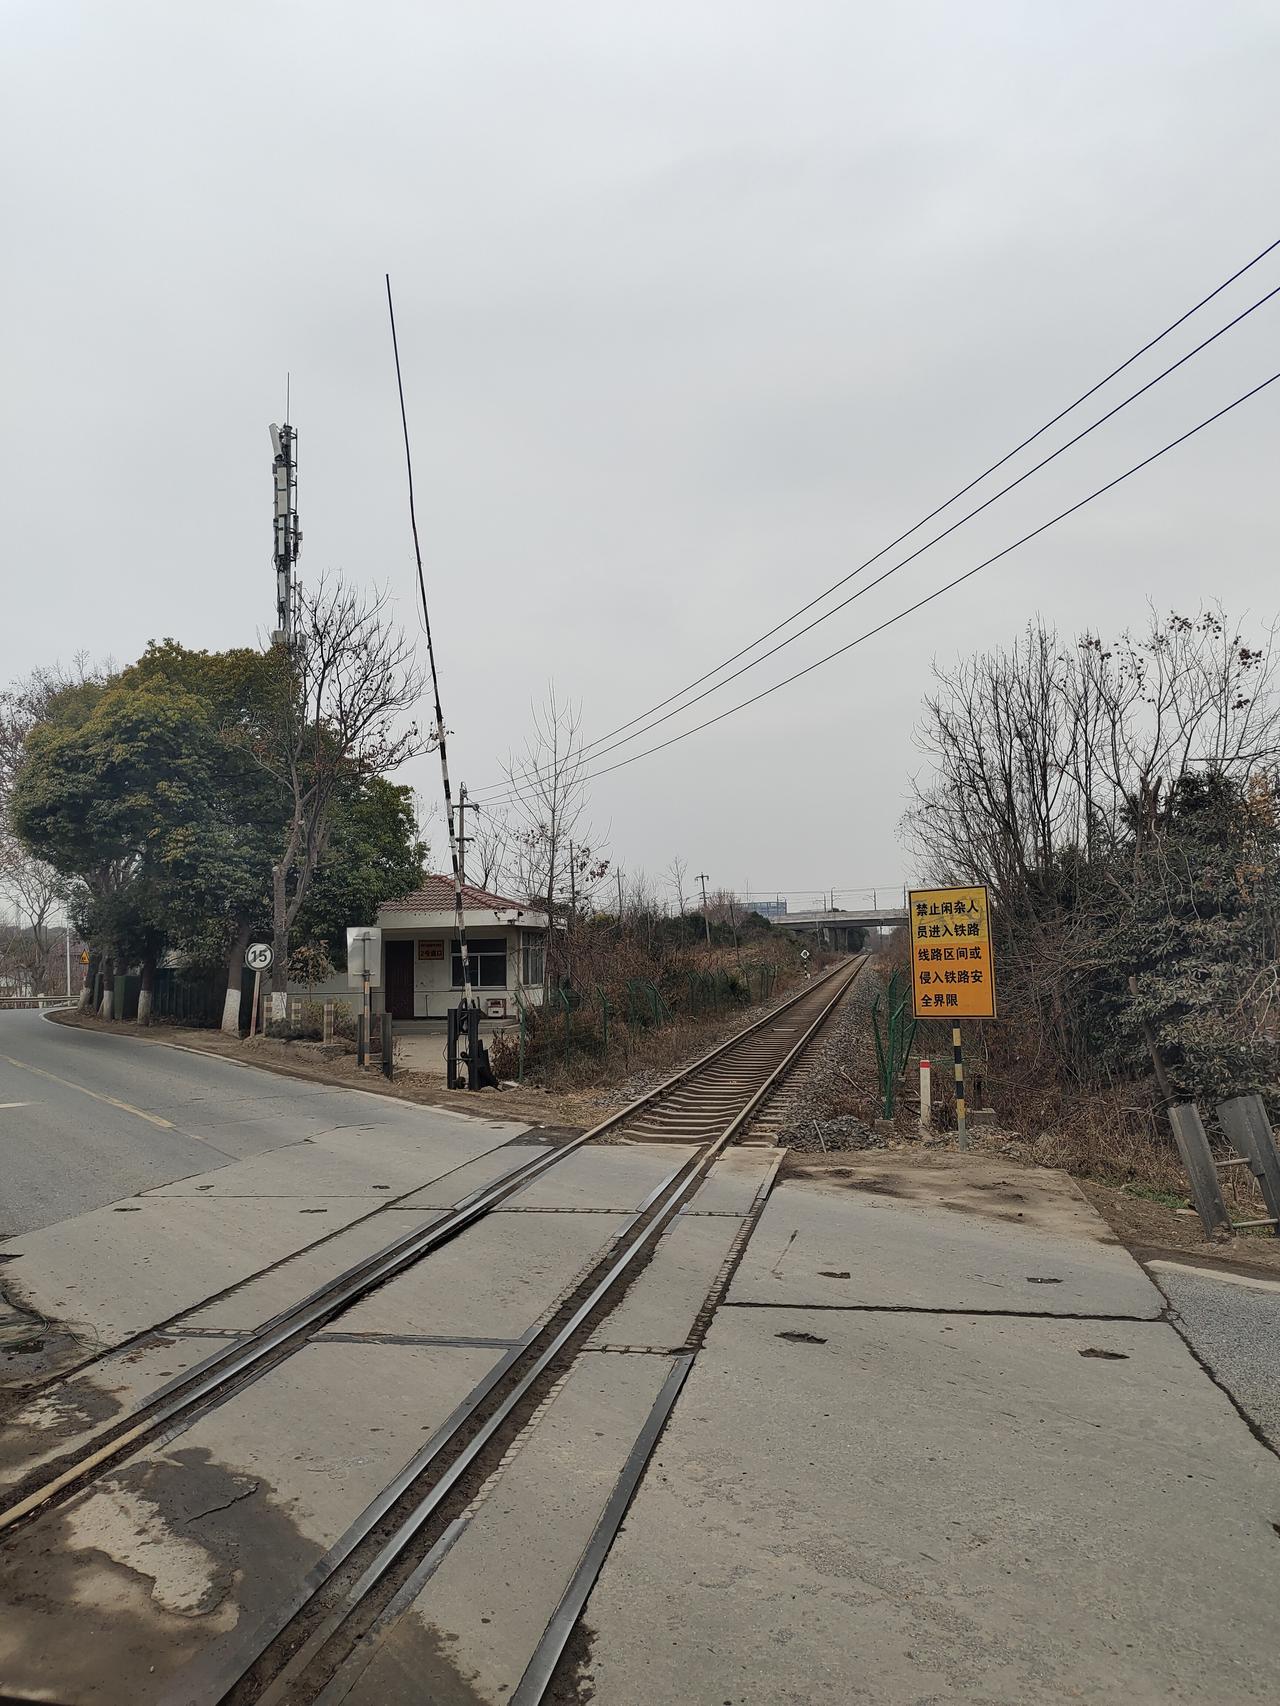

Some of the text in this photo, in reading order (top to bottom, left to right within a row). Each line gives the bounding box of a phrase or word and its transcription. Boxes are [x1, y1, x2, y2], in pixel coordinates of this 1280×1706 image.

[916, 900, 978, 917] 禁止闲杂人
[917, 923, 979, 939] 员进入铁路
[251, 949, 268, 963] 15
[918, 946, 981, 962] 线路区间或
[919, 970, 983, 985] 侵入铁路安
[921, 994, 958, 1008] 全界限
